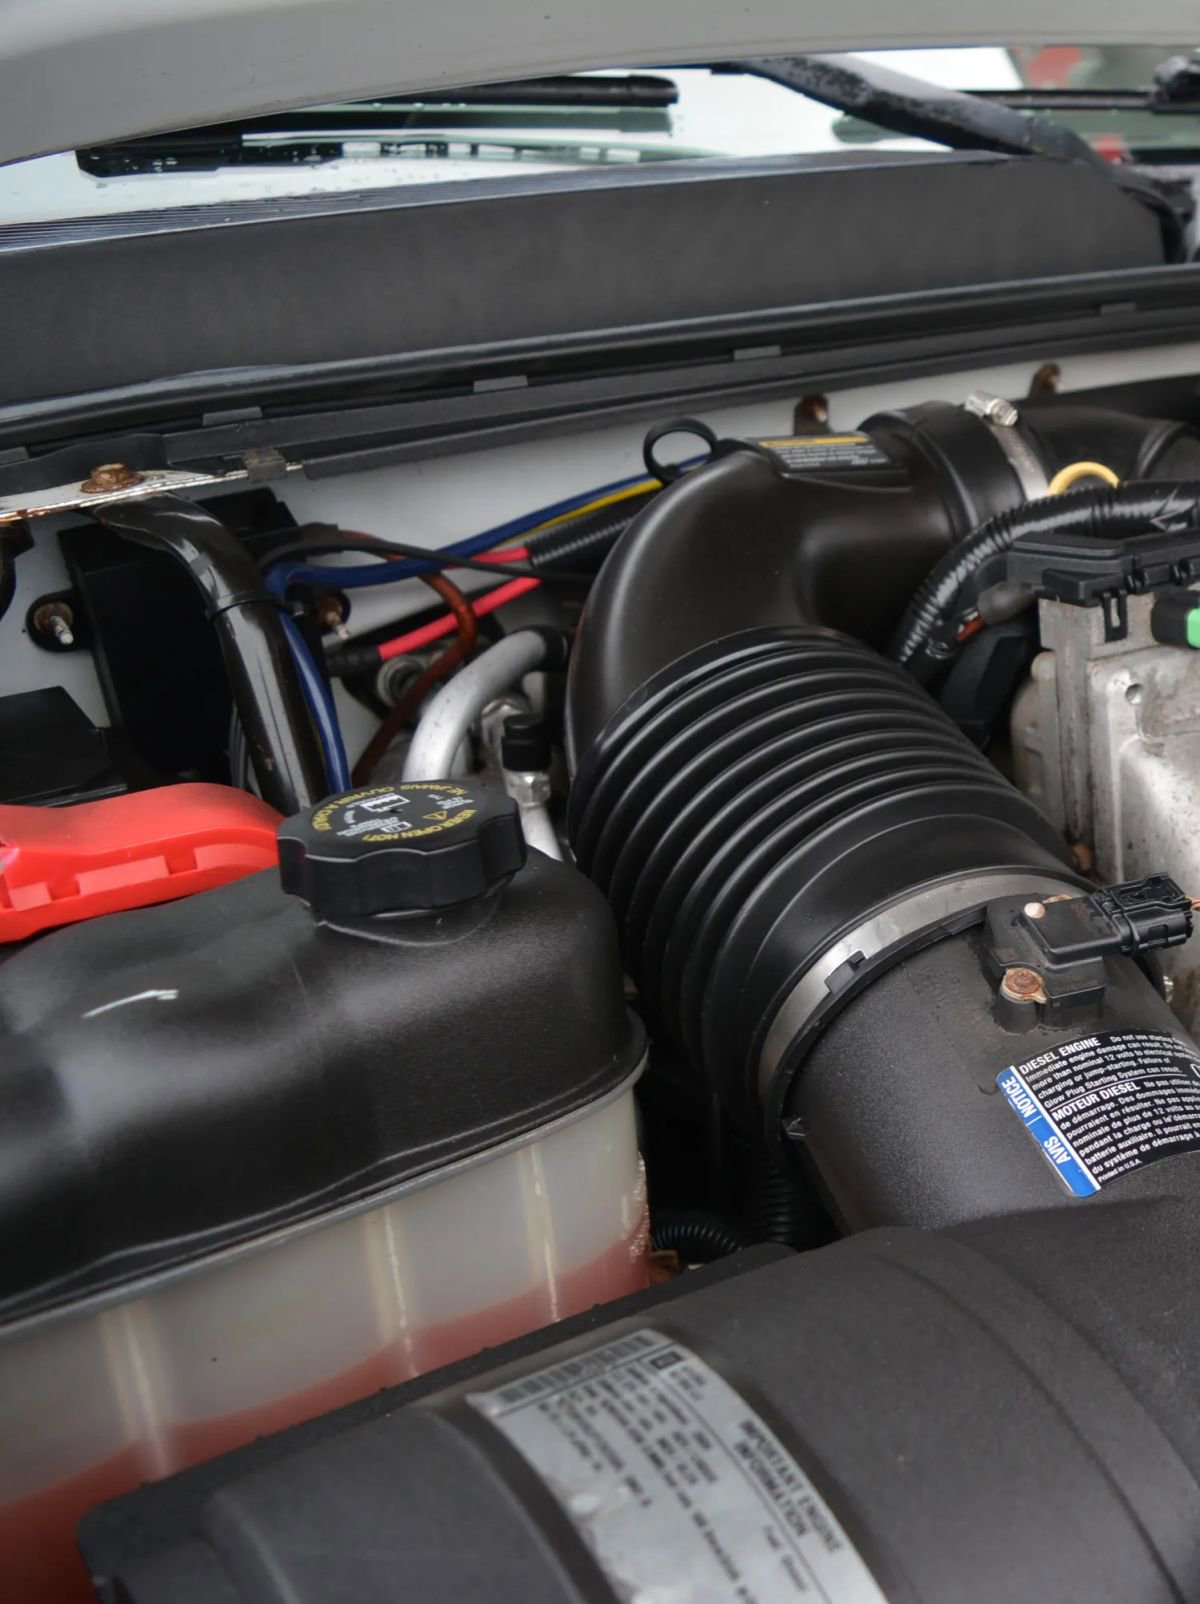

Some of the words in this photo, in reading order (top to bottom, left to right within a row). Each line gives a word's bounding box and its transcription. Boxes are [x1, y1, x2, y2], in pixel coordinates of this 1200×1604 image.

[362, 833, 400, 842] HOT!
[402, 825, 442, 838] OPEN
[1019, 1051, 1060, 1075] DIESEL
[1058, 1037, 1101, 1056] ENGINE
[1025, 1060, 1068, 1082] Immediate
[1069, 1050, 1096, 1064] engine
[1096, 1044, 1126, 1054] damage
[1032, 1077, 1053, 1091] more
[1052, 1068, 1072, 1080] than
[1072, 1056, 1104, 1072] nominal
[1104, 1054, 1116, 1062] 12
[1116, 1051, 1134, 1059] volts
[1001, 1076, 1036, 1119] NOTICE
[1038, 1078, 1074, 1100] charging
[1074, 1074, 1083, 1082] or
[1083, 1060, 1138, 1080] jump-starting.
[1043, 1094, 1065, 1108] Glow
[1065, 1085, 1086, 1098] Plug
[1084, 1074, 1118, 1090] Starting
[1117, 1068, 1146, 1080] System
[1052, 1093, 1100, 1121] MOTEUR
[1099, 1081, 1142, 1100] DIESEL
[1060, 1122, 1072, 1130] de
[1072, 1102, 1118, 1124] démarrage.
[1118, 1096, 1135, 1104] Des
[1136, 1088, 1176, 1100] dommages
[1066, 1114, 1110, 1140] pourraient
[1121, 1100, 1154, 1114] résulter.
[1072, 1126, 1110, 1148] nominale
[1111, 1120, 1122, 1129] de
[1123, 1114, 1141, 1126] plus
[1142, 1110, 1153, 1118] de
[1154, 1107, 1165, 1115] 12
[1078, 1135, 1113, 1158] pendant
[1113, 1132, 1123, 1140] la
[1123, 1122, 1152, 1136] charge
[1152, 1118, 1163, 1126] ou
[1084, 1146, 1117, 1166] batterie
[1117, 1132, 1156, 1150] auxiliaire.
[1162, 1122, 1192, 1134] pourrait
[1044, 1136, 1071, 1164] AVIS
[1092, 1164, 1104, 1175] du
[1104, 1148, 1139, 1168] système
[1139, 1143, 1151, 1152] de
[1152, 1132, 1194, 1148] démarrage
[1098, 1170, 1118, 1182] Printed
